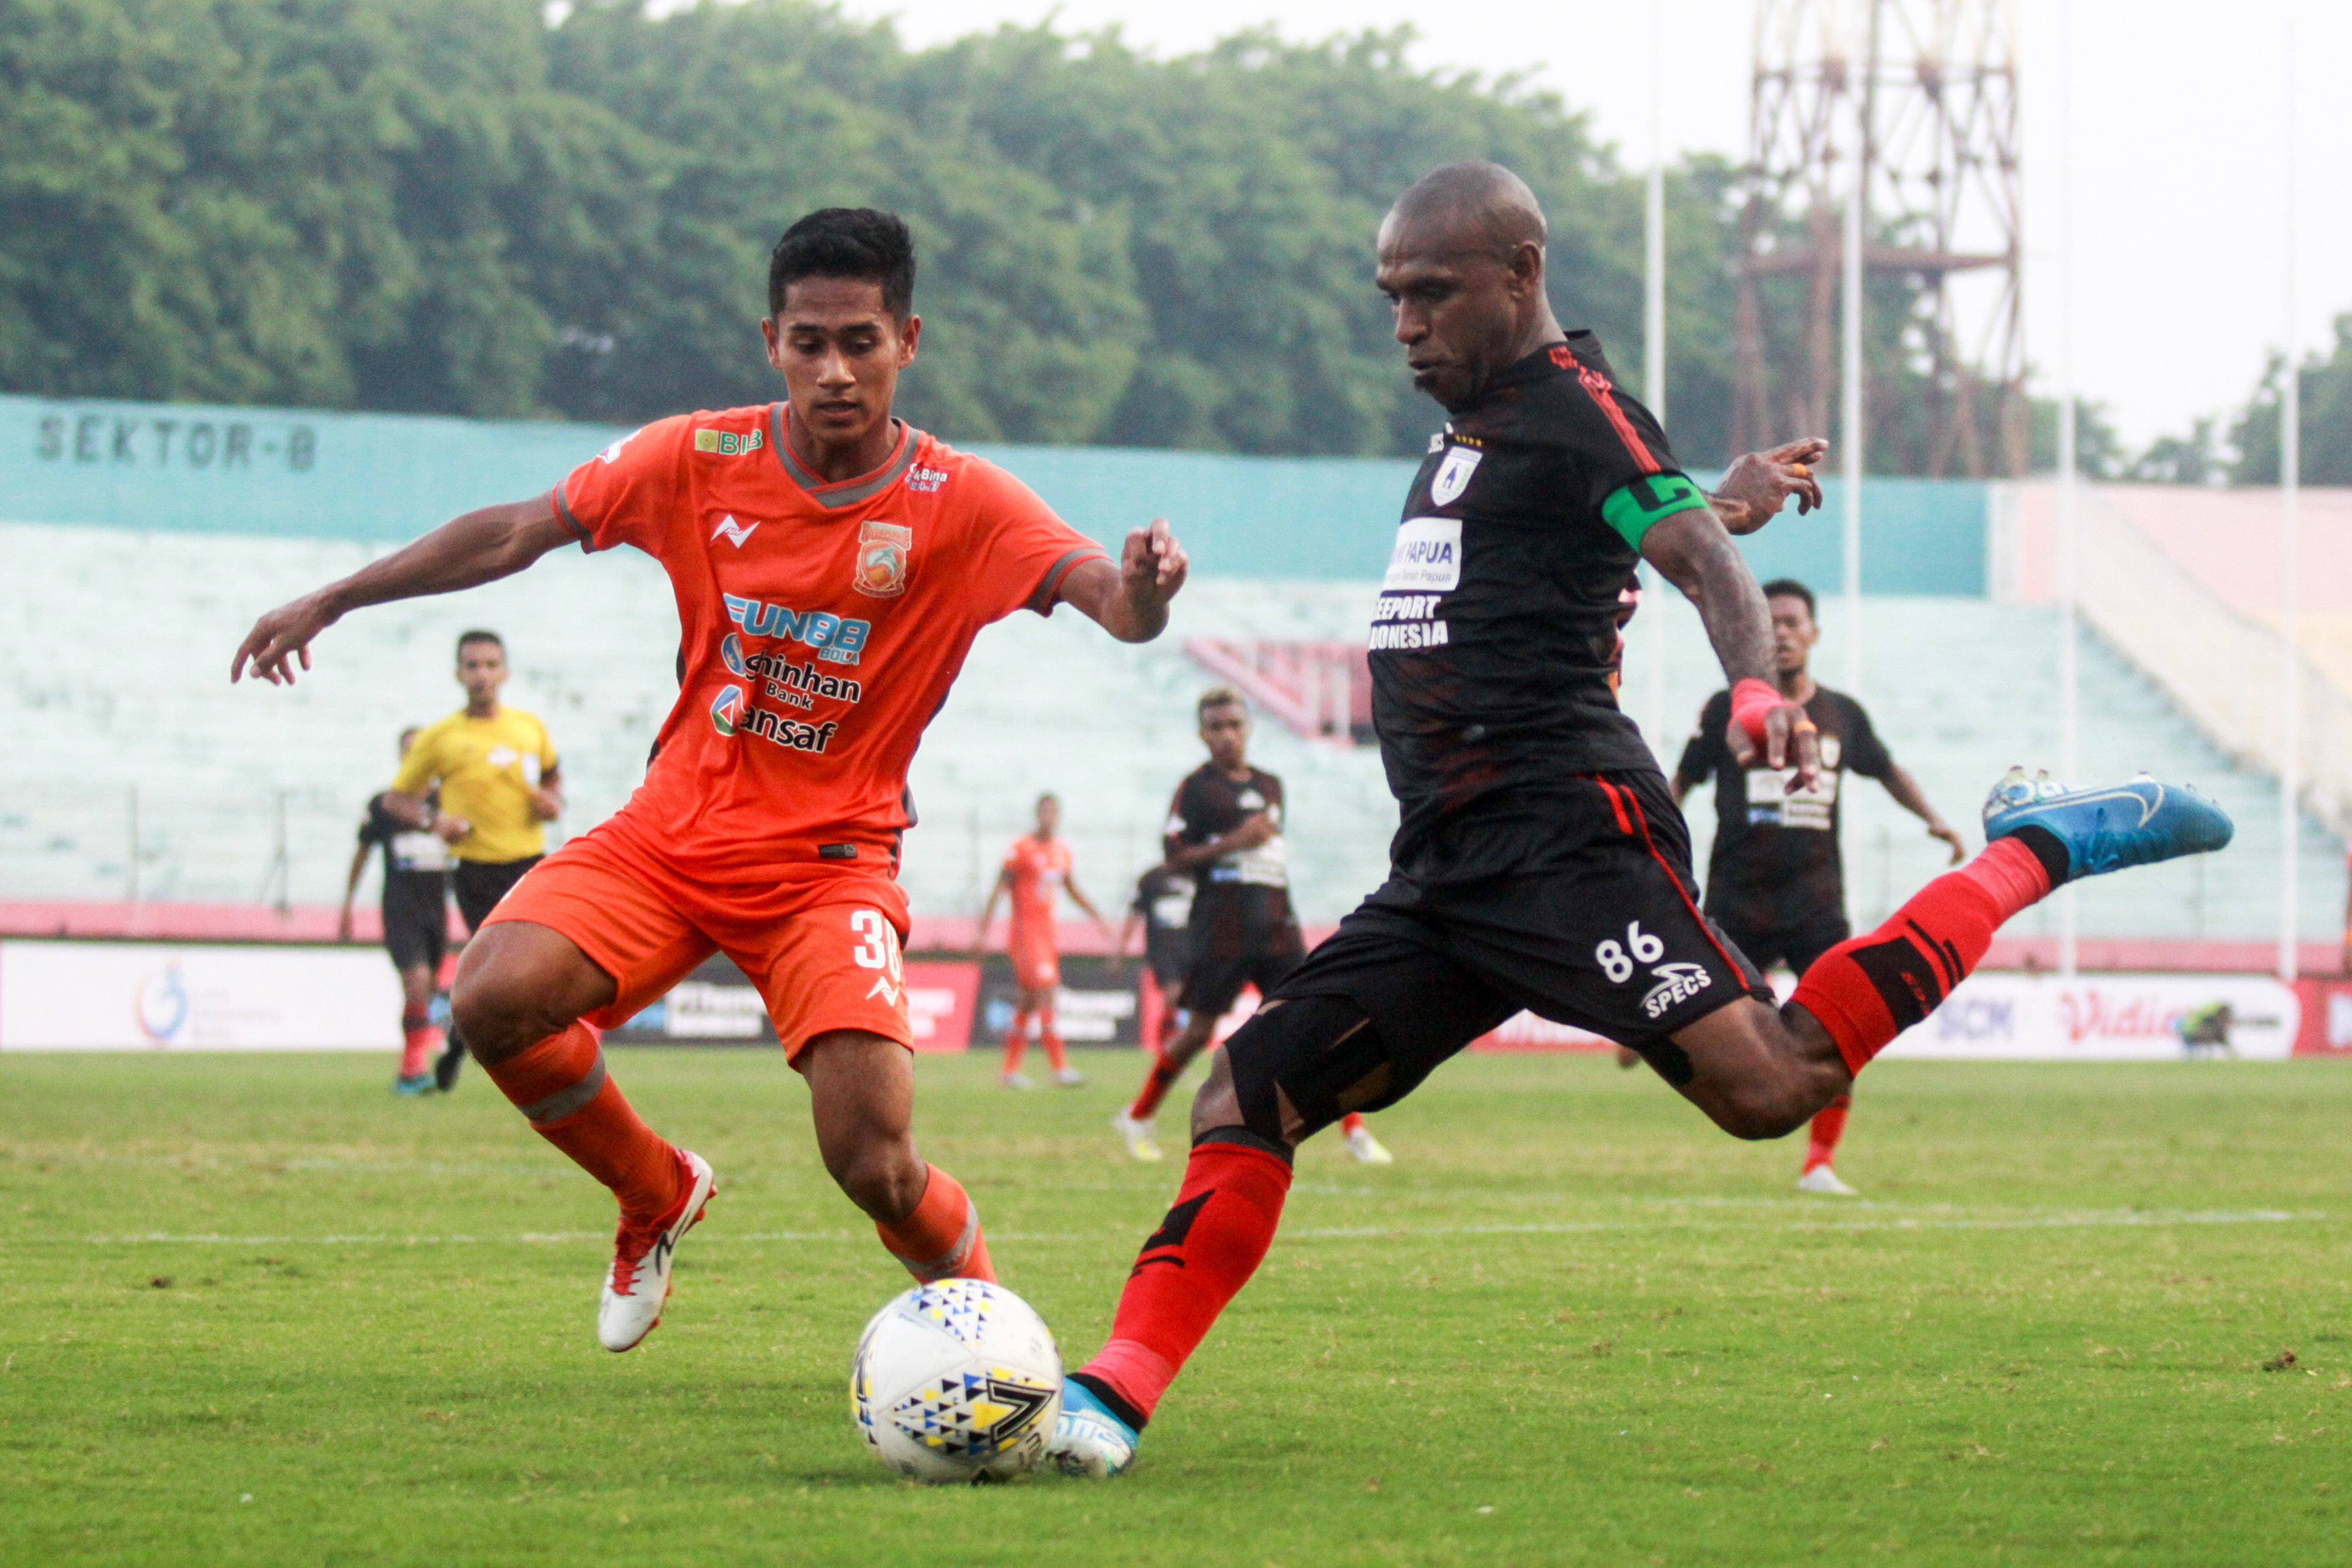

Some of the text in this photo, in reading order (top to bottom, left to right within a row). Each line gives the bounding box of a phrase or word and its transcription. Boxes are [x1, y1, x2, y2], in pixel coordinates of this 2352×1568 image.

[1406, 541, 1453, 564] PAPUA
[1421, 569, 1452, 584] Papua
[817, 646, 860, 666] BOLA
[766, 681, 814, 710] Bank
[1595, 920, 1664, 984] 86
[1646, 969, 1712, 1018] SPECS
